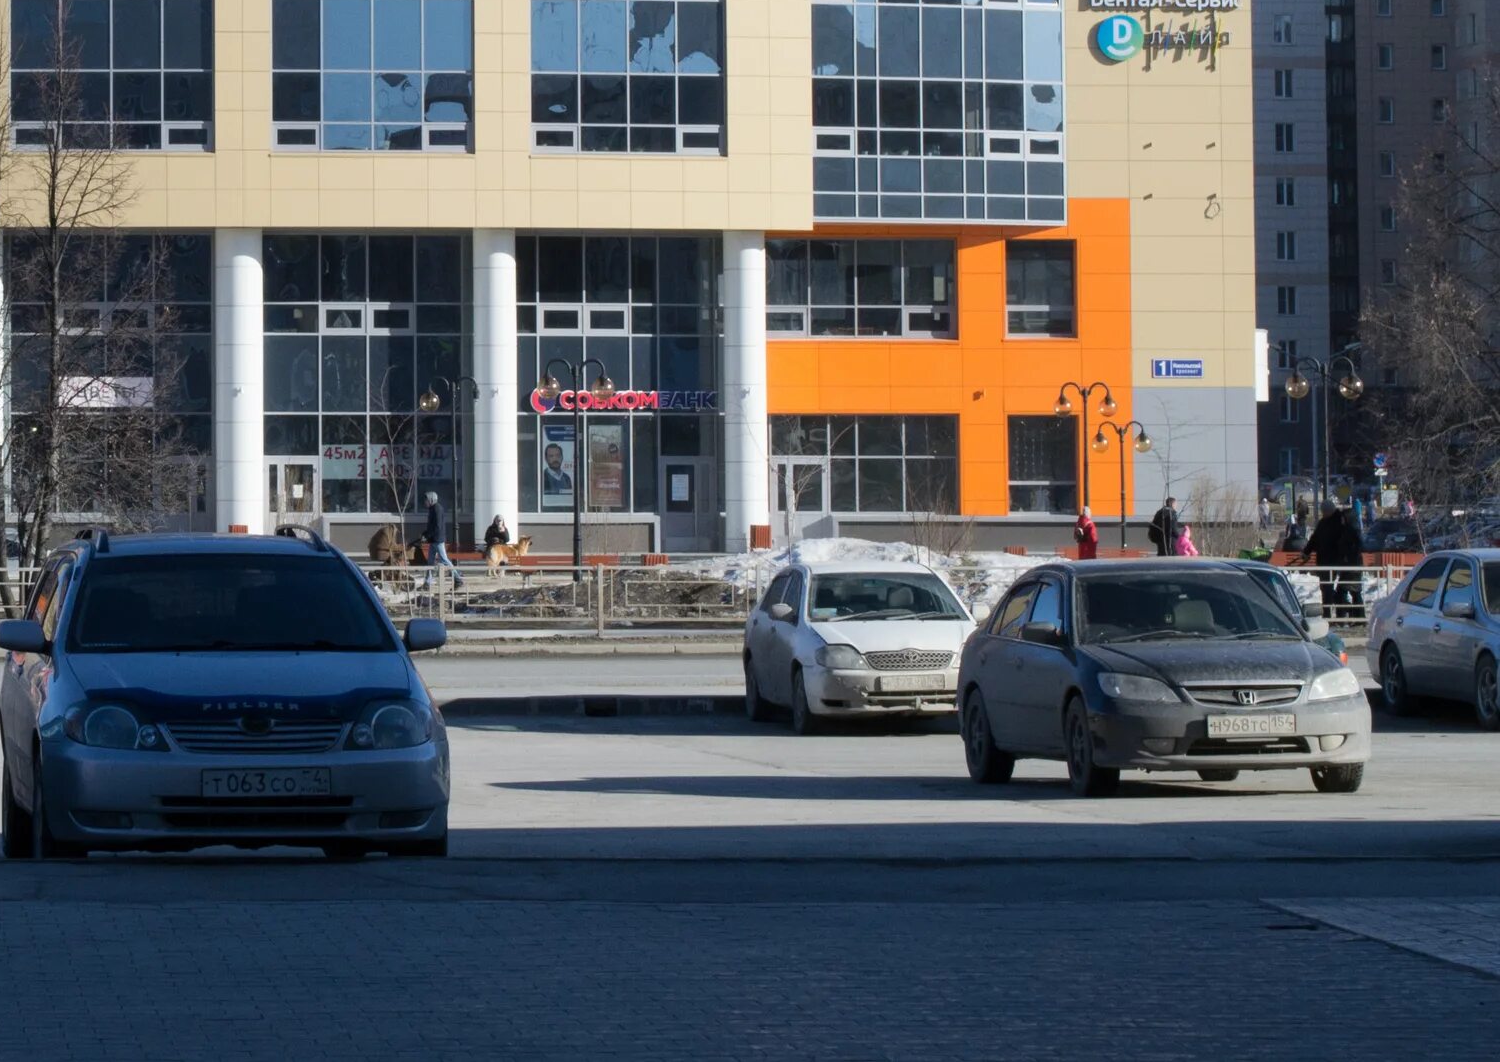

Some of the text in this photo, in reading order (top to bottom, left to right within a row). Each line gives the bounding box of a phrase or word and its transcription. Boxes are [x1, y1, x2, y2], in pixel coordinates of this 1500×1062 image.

[1158, 360, 1167, 376] 1
[202, 701, 300, 711] FIELDER
[1212, 718, 1268, 733] Н968ТС
[211, 772, 297, 795] Т063СО
